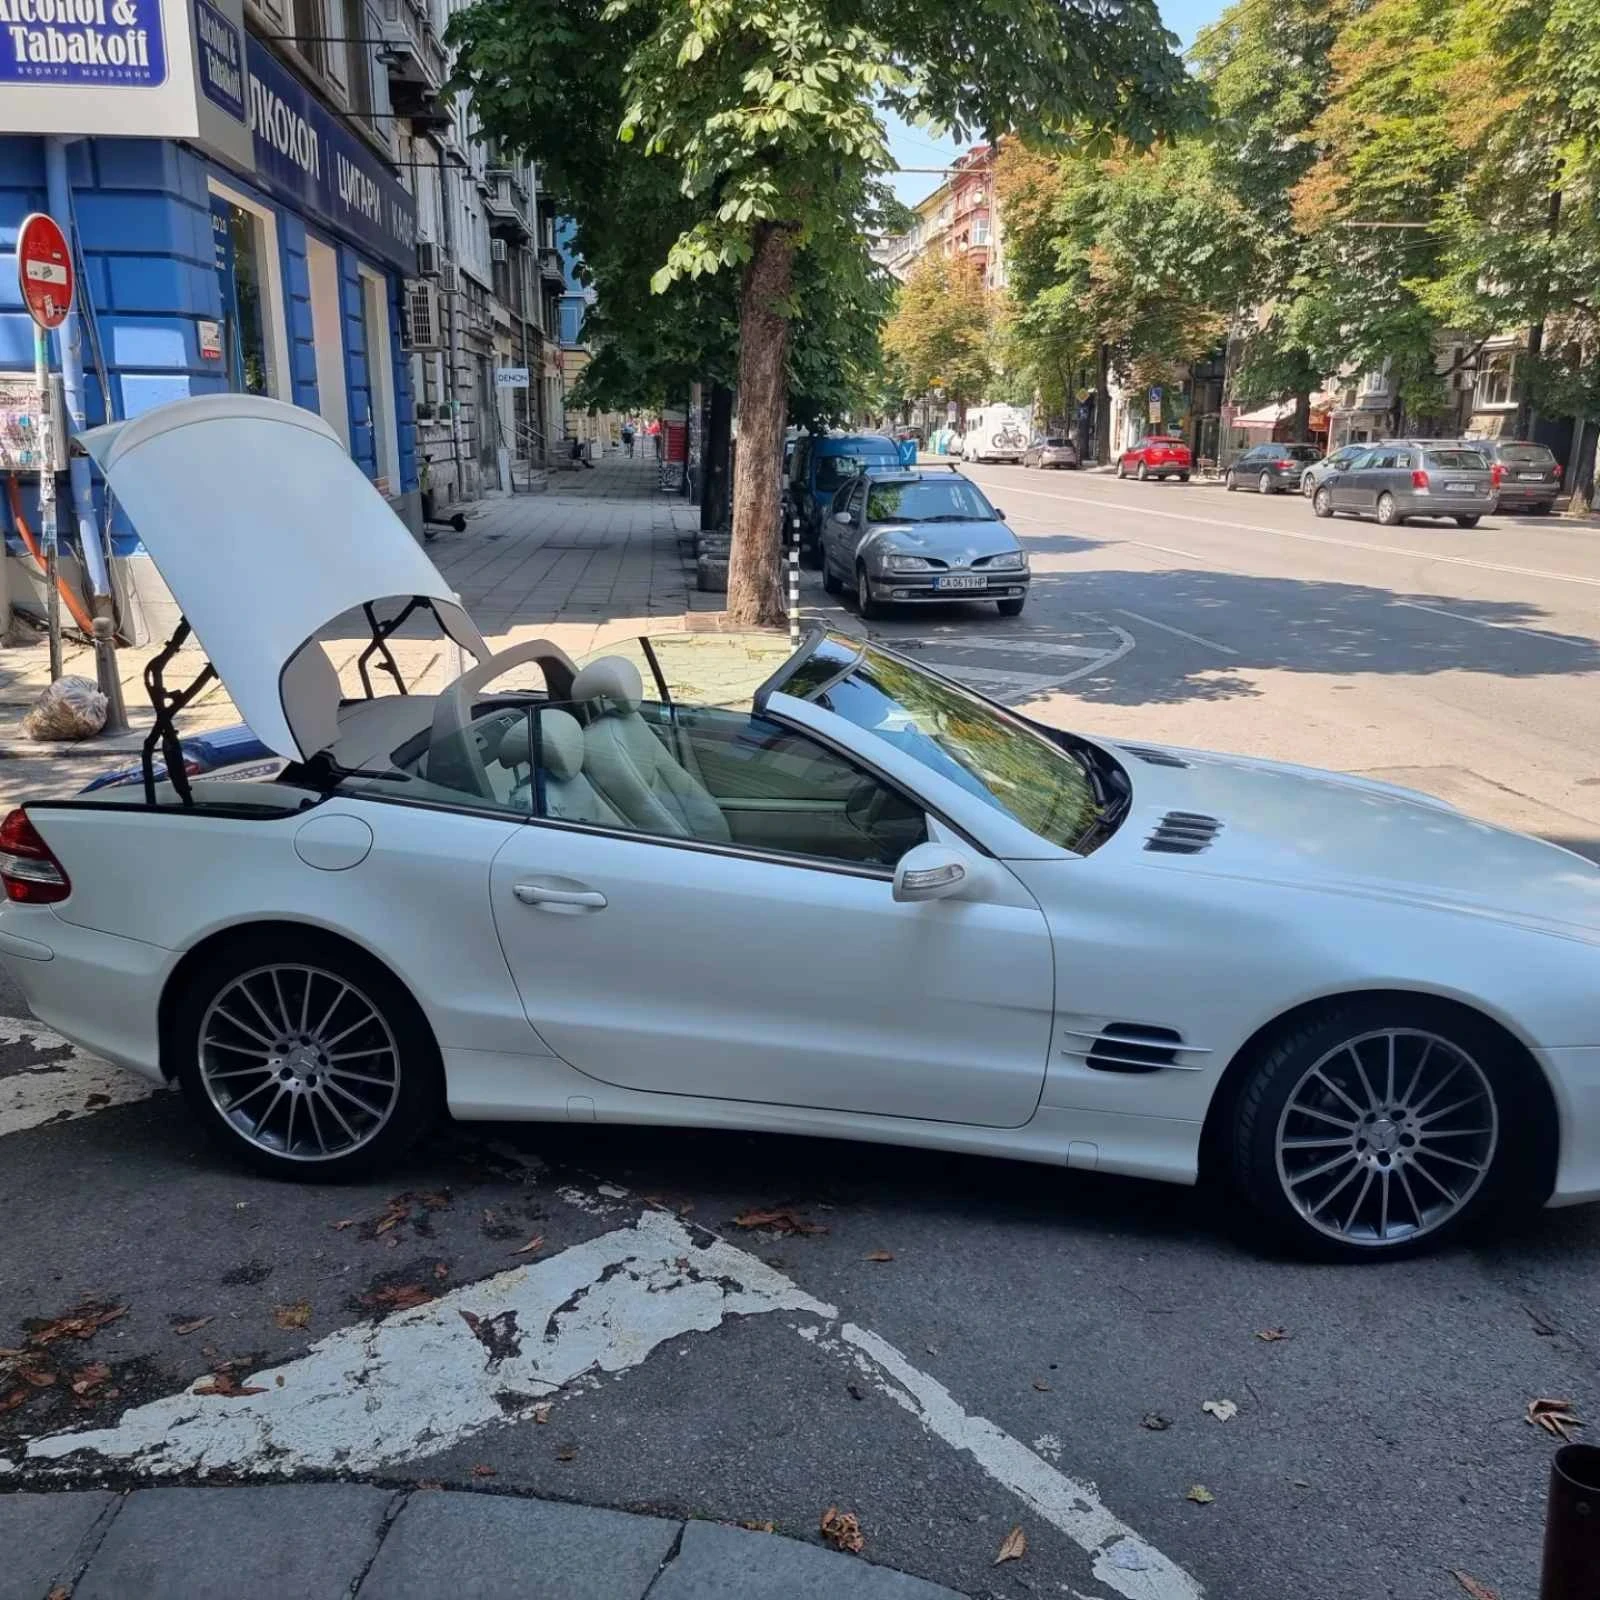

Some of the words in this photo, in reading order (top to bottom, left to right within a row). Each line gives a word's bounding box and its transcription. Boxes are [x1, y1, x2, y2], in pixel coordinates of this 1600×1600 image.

[112, 0, 138, 26] &
[9, 26, 149, 67] Tabakoff
[249, 72, 320, 181] ЛКОХОЛ
[337, 151, 381, 227] ЦИГАРИ
